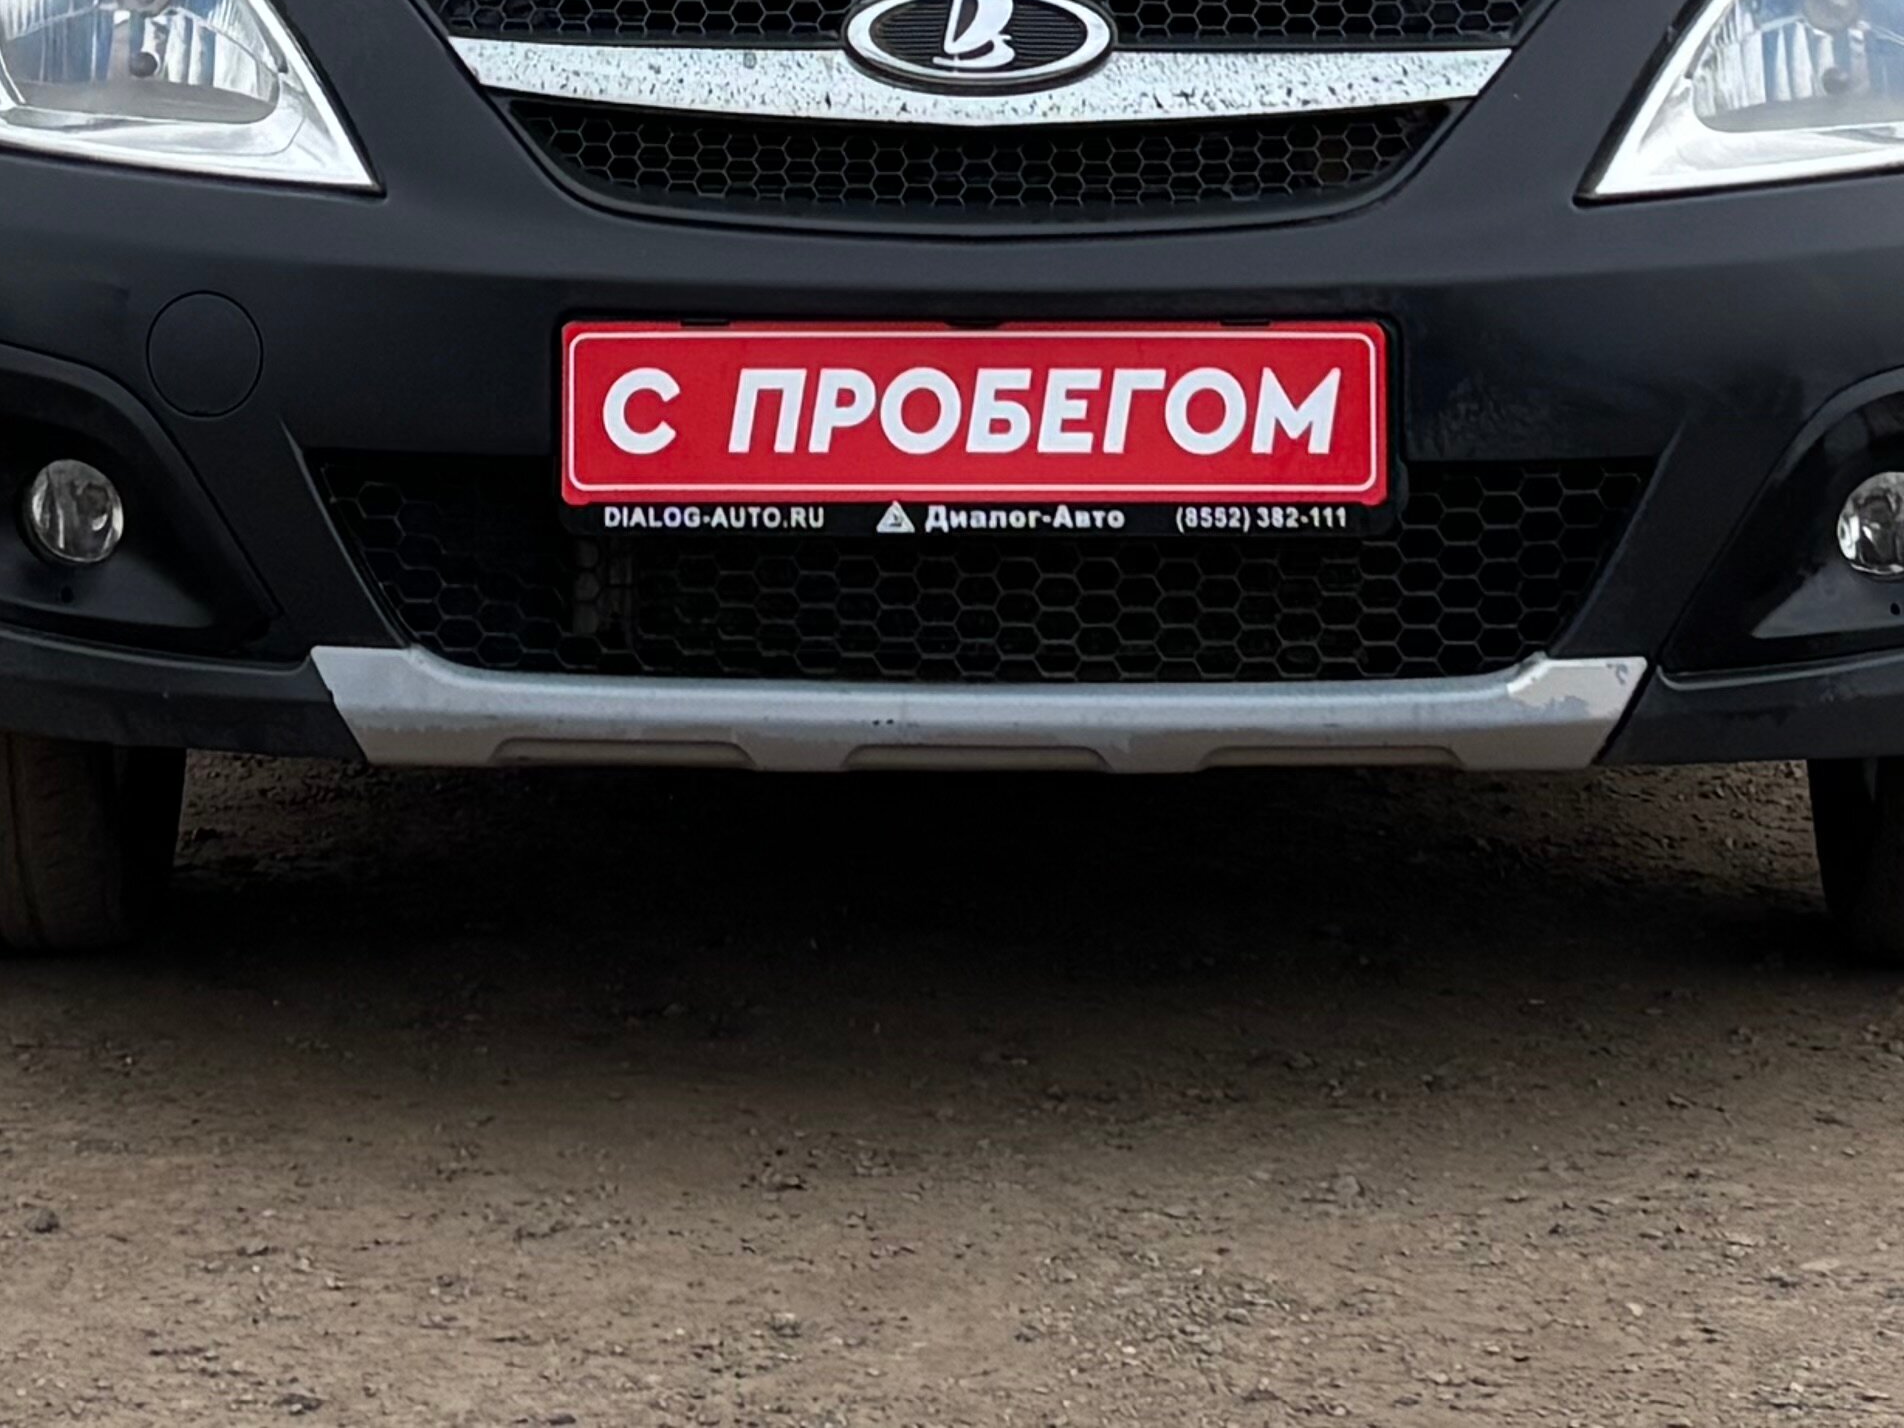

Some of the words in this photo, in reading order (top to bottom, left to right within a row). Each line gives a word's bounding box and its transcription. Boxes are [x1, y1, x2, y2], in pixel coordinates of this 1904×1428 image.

[603, 367, 680, 455] С
[728, 367, 1341, 455] ПРОБЕГОМ
[604, 506, 825, 529] DIALOG-AUTO.RU
[924, 504, 1125, 533] Диалог-Авто
[1175, 506, 1251, 533] (8552)
[1256, 506, 1346, 529] 382-111
